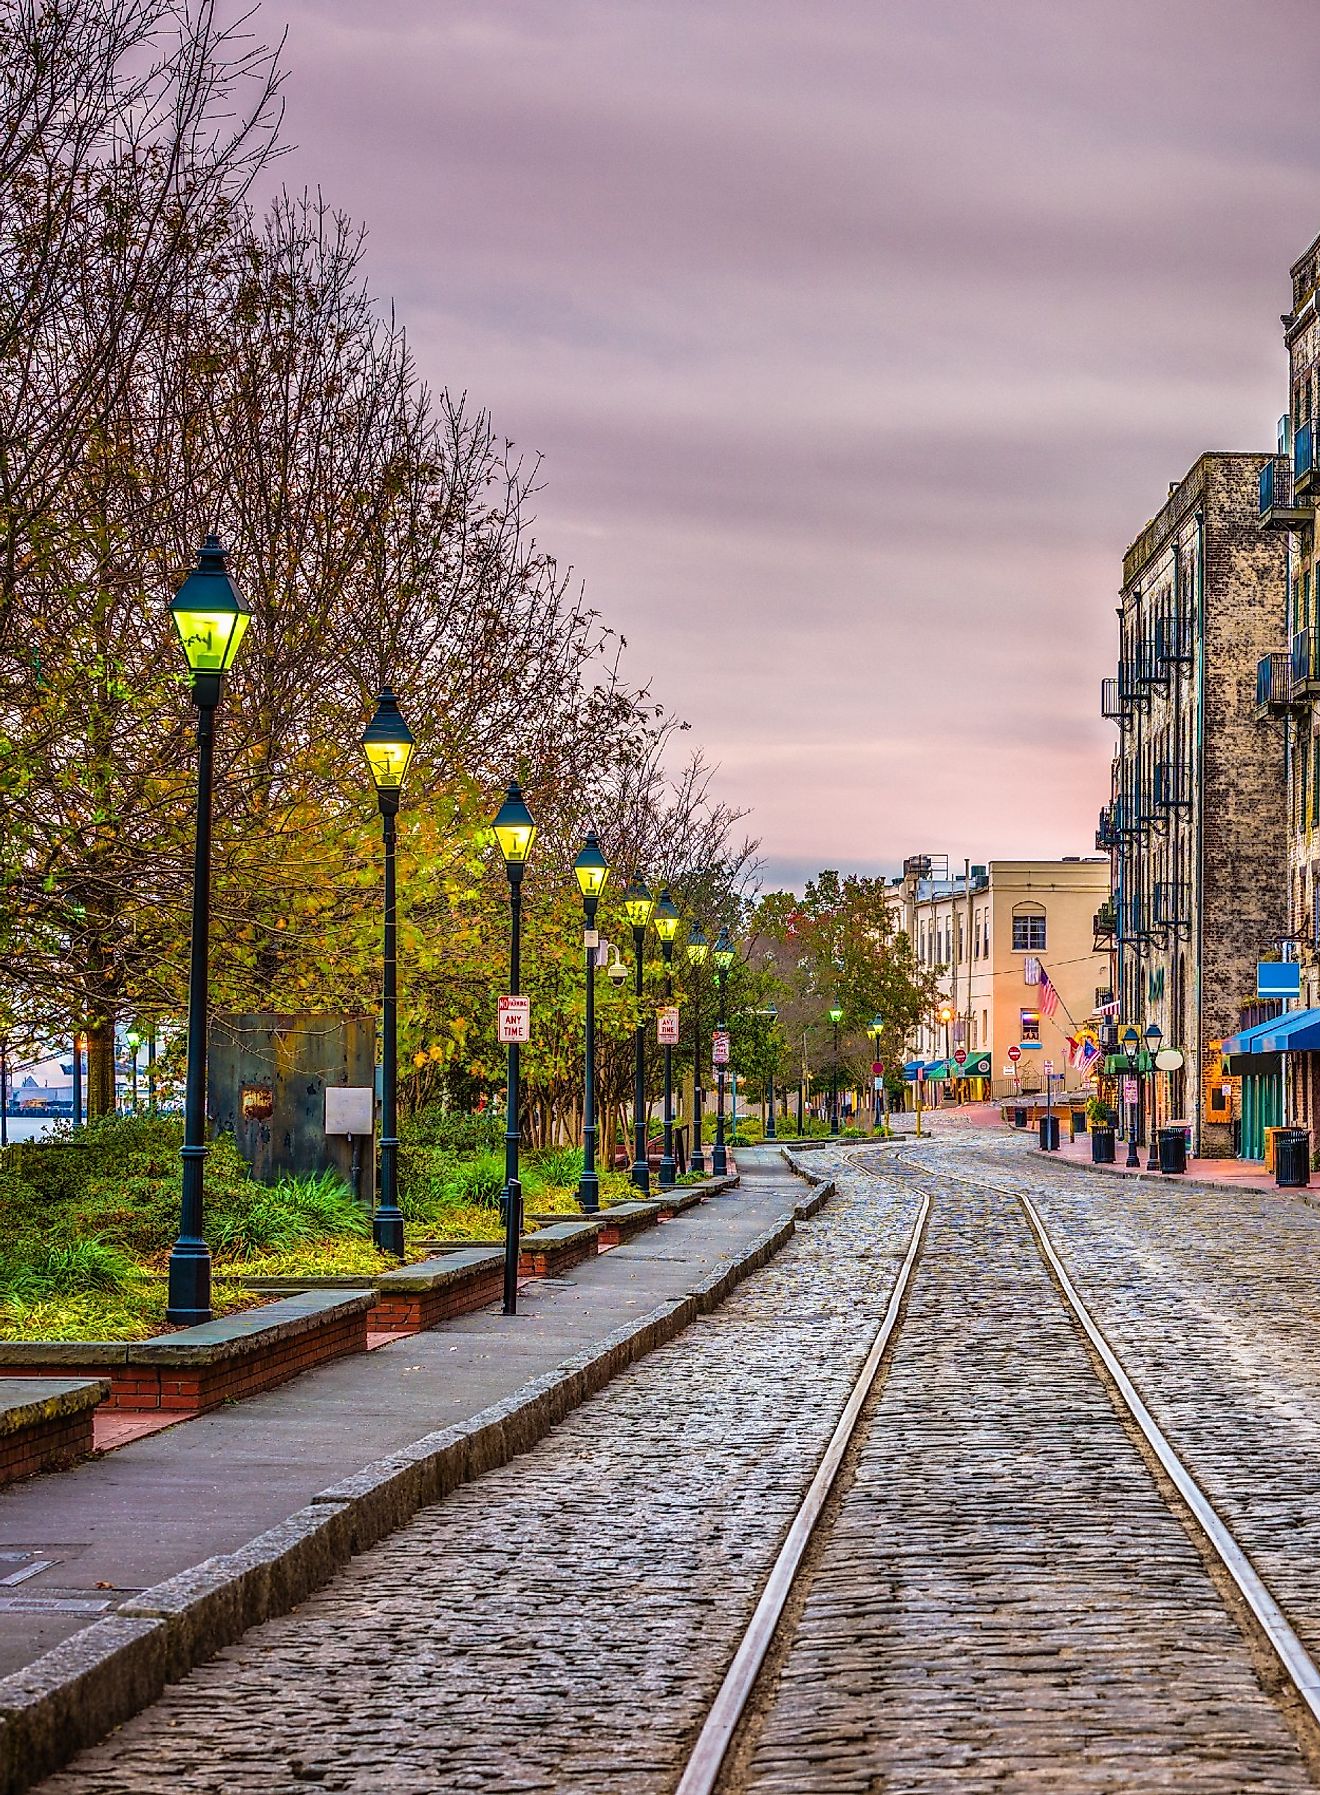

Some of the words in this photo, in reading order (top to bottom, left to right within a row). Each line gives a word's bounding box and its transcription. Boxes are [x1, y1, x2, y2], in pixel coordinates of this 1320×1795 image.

[500, 999, 509, 1009] NO
[505, 1015, 522, 1025] ANY
[662, 1018, 674, 1026] ANY
[504, 1026, 523, 1036] TIME
